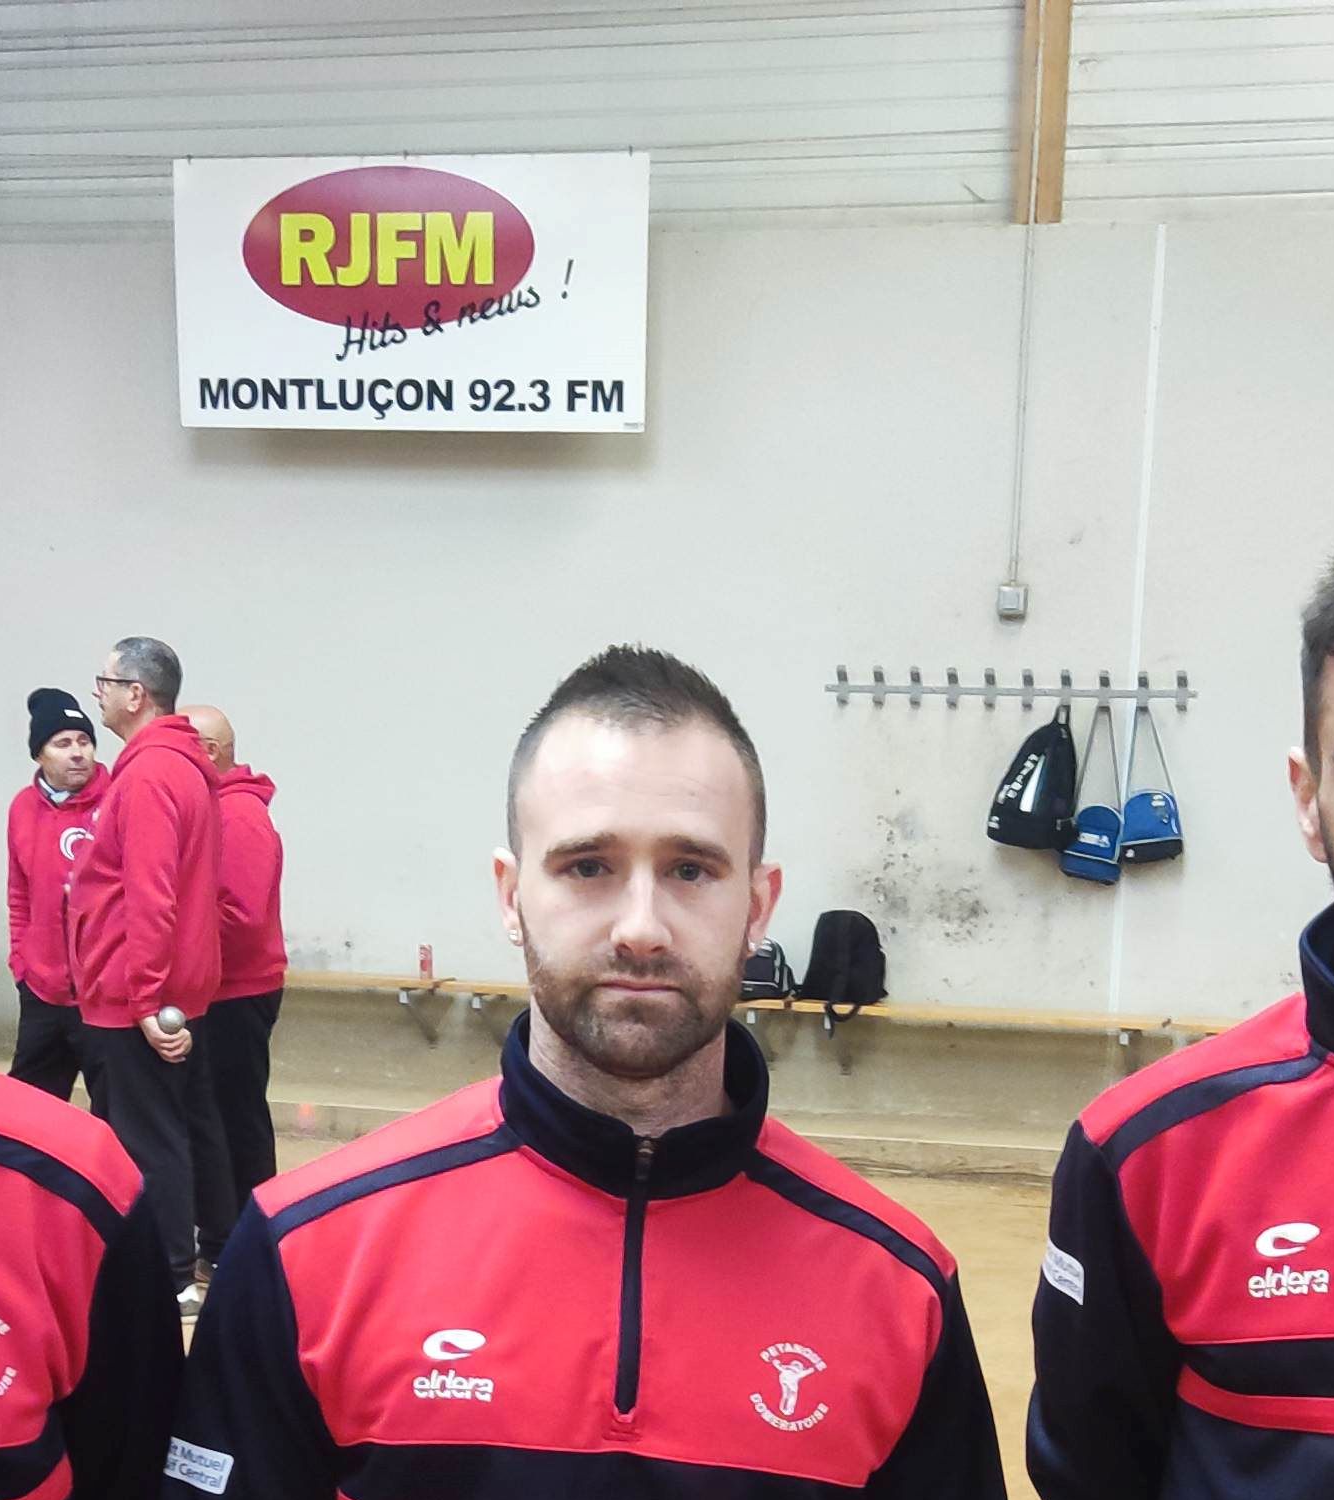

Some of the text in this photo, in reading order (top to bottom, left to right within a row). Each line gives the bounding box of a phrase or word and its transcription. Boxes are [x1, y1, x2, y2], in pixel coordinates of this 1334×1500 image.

[279, 211, 495, 287] RJFM
[335, 310, 407, 362] Hits
[422, 300, 444, 336] &
[457, 286, 541, 328] news
[198, 378, 624, 420] MONTLUÇON 92.3 FM
[1248, 1264, 1330, 1298] eldera
[412, 1369, 495, 1403] eldera
[178, 1463, 224, 1488] Central
[180, 1446, 227, 1472] Mutuel
